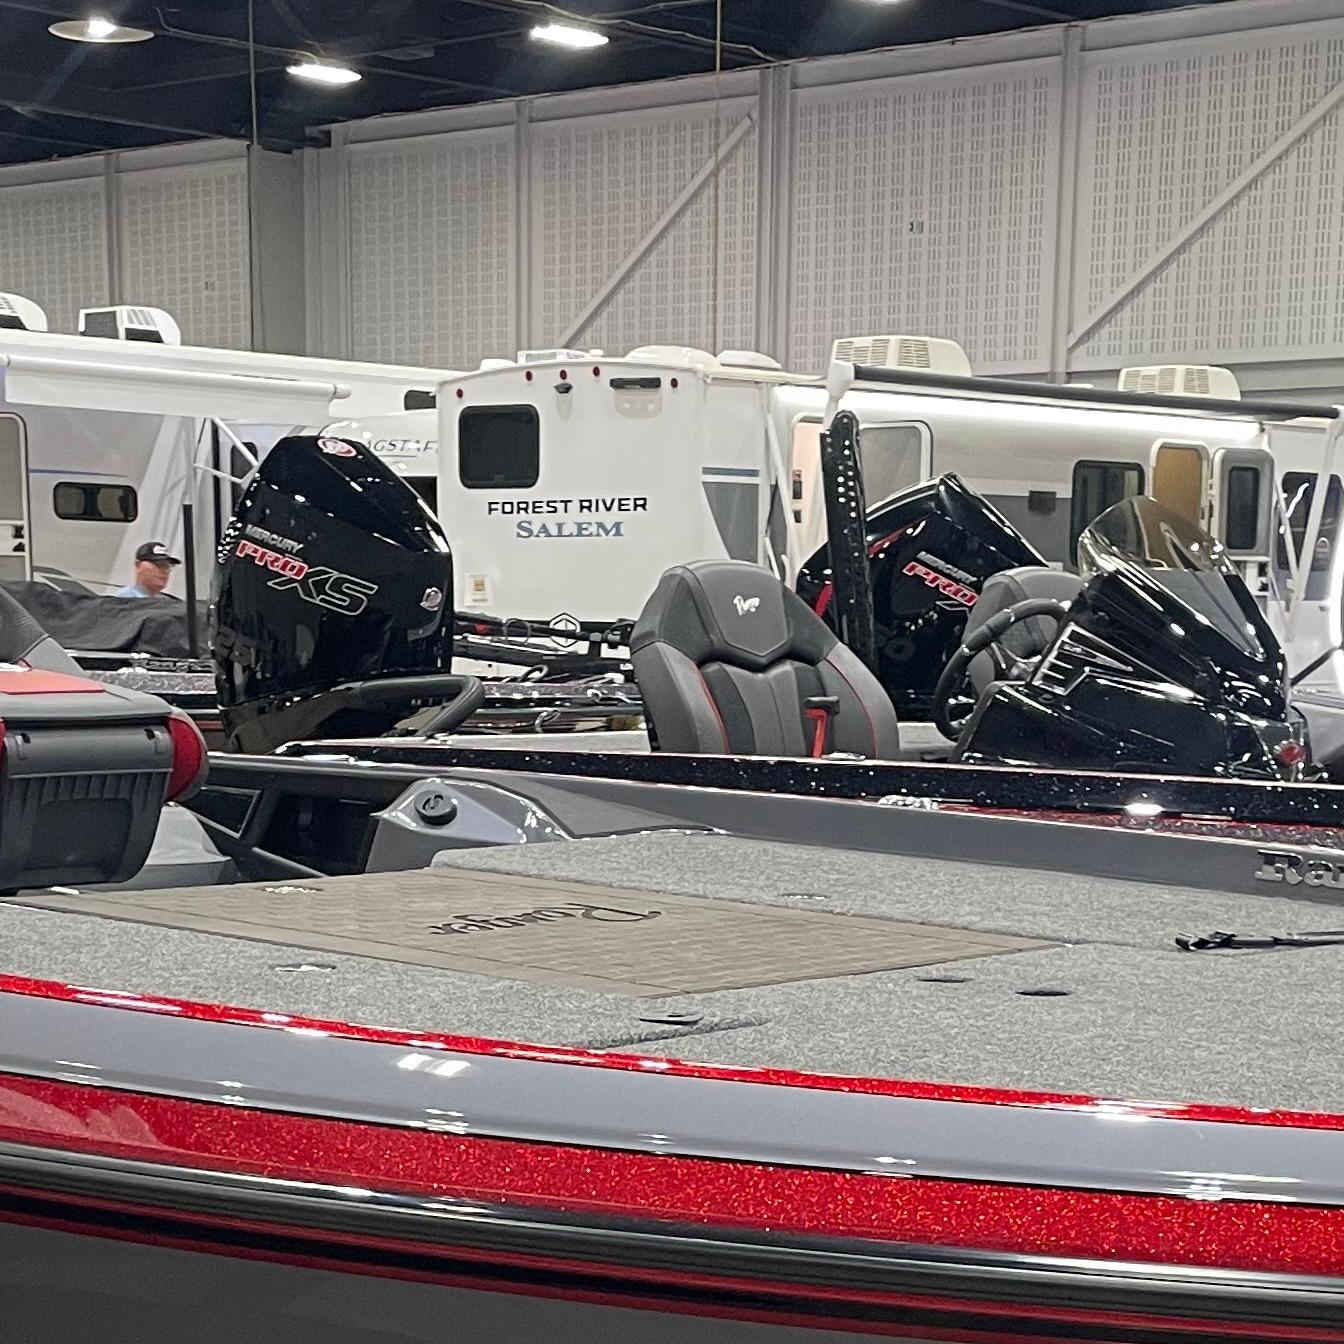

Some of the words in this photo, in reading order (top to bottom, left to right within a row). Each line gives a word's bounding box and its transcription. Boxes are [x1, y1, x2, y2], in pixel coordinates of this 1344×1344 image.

[487, 499, 573, 516] FOREST
[579, 497, 649, 514] RIVER
[245, 524, 304, 553] MERCURY
[516, 520, 625, 539] SALEM
[235, 539, 309, 580] PRO
[267, 566, 380, 616] XS
[902, 561, 980, 607] PRO
[427, 902, 662, 935] Ranger
